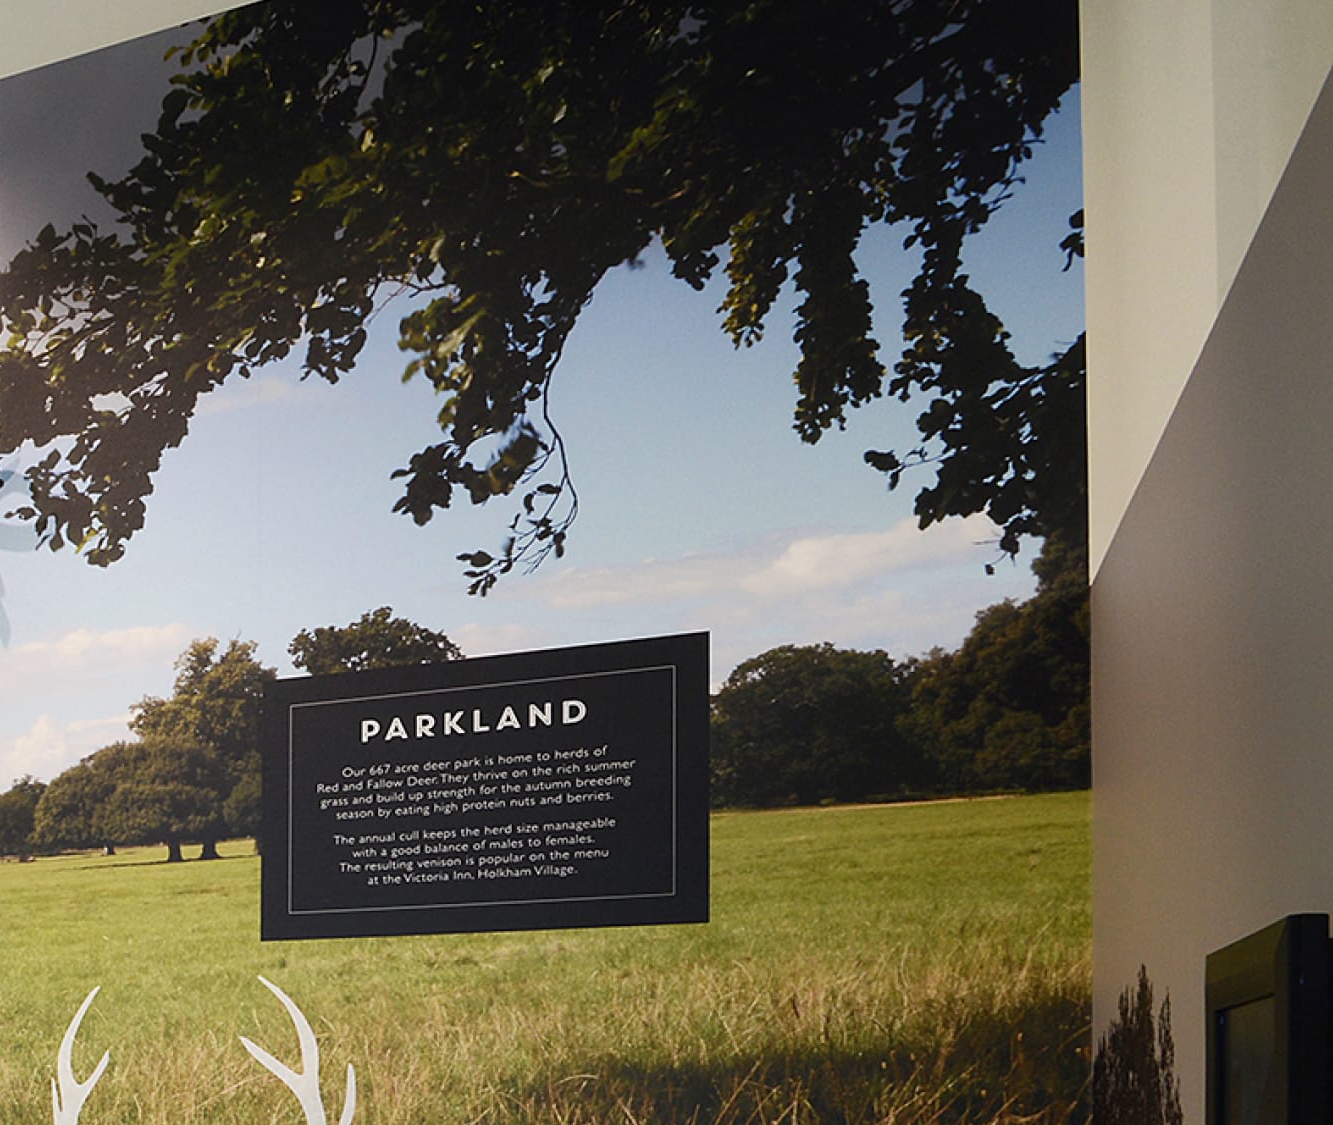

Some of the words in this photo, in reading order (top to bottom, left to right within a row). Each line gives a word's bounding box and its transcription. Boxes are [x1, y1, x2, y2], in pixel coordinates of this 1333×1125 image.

[361, 700, 587, 743] PARKLAND
[316, 782, 340, 793] Red
[342, 780, 364, 792] and
[366, 778, 404, 790] Fallow
[439, 773, 470, 785] They
[472, 771, 508, 782] thrive
[511, 769, 528, 778] on
[531, 766, 553, 777] the
[556, 762, 581, 775] rich
[584, 759, 636, 773] summer
[341, 766, 367, 778] Our
[368, 763, 391, 776] 667
[394, 764, 420, 774] acre
[423, 761, 452, 772] deer
[453, 756, 481, 771] park
[484, 757, 494, 766] is
[497, 754, 533, 765] home
[536, 752, 551, 762] to
[553, 747, 589, 760] herds
[592, 744, 608, 757] of
[319, 797, 349, 810] grass
[351, 793, 374, 805] and
[375, 791, 405, 804] build
[407, 791, 424, 803] up
[427, 786, 476, 800] strength
[479, 783, 498, 795] for
[501, 783, 521, 794] the
[524, 780, 572, 792] autumn
[575, 774, 631, 788] breeding
[335, 809, 374, 820] season
[377, 807, 393, 819] by
[394, 804, 430, 817] eating
[433, 801, 459, 815] high
[462, 800, 506, 813] protein
[509, 797, 536, 807] nuts
[539, 793, 563, 805] and
